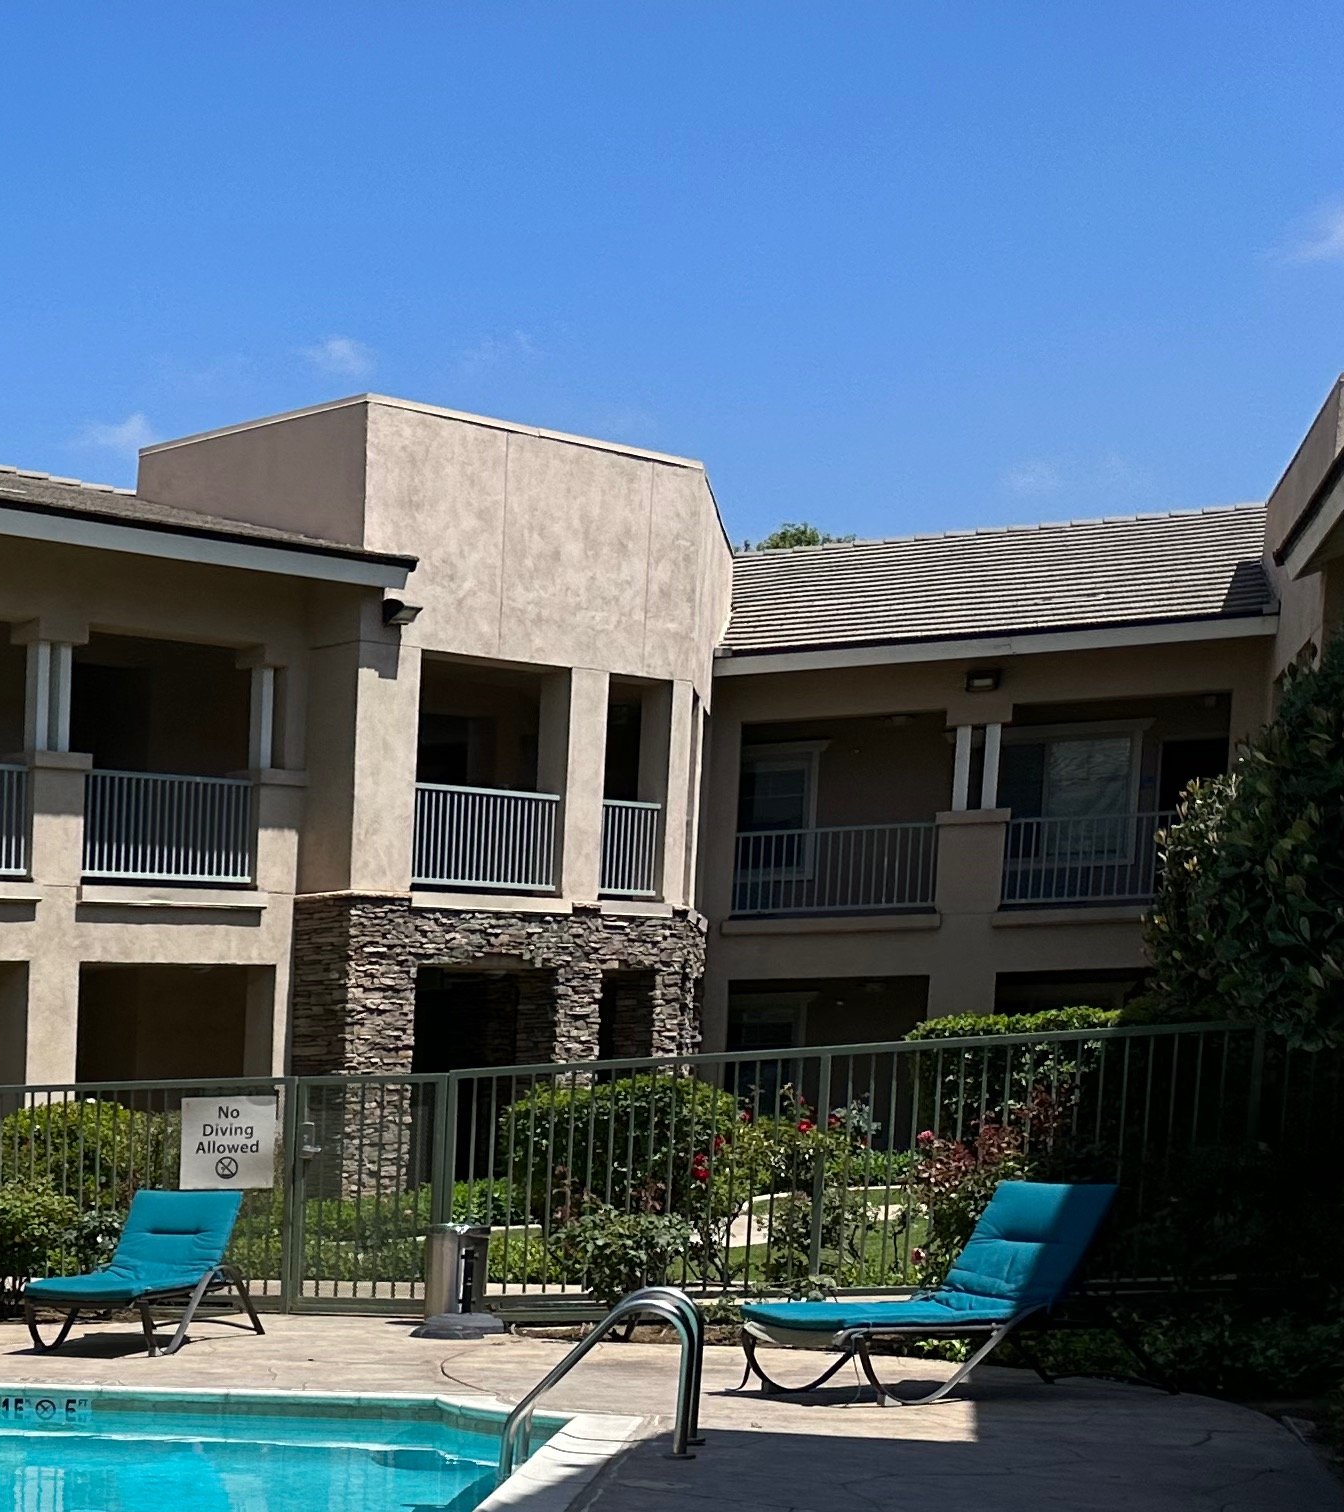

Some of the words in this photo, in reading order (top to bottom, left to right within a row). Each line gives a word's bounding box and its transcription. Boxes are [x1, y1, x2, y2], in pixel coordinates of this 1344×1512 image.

[218, 1106, 240, 1119] No
[202, 1123, 254, 1139] Diving
[195, 1140, 260, 1154] Allowed
